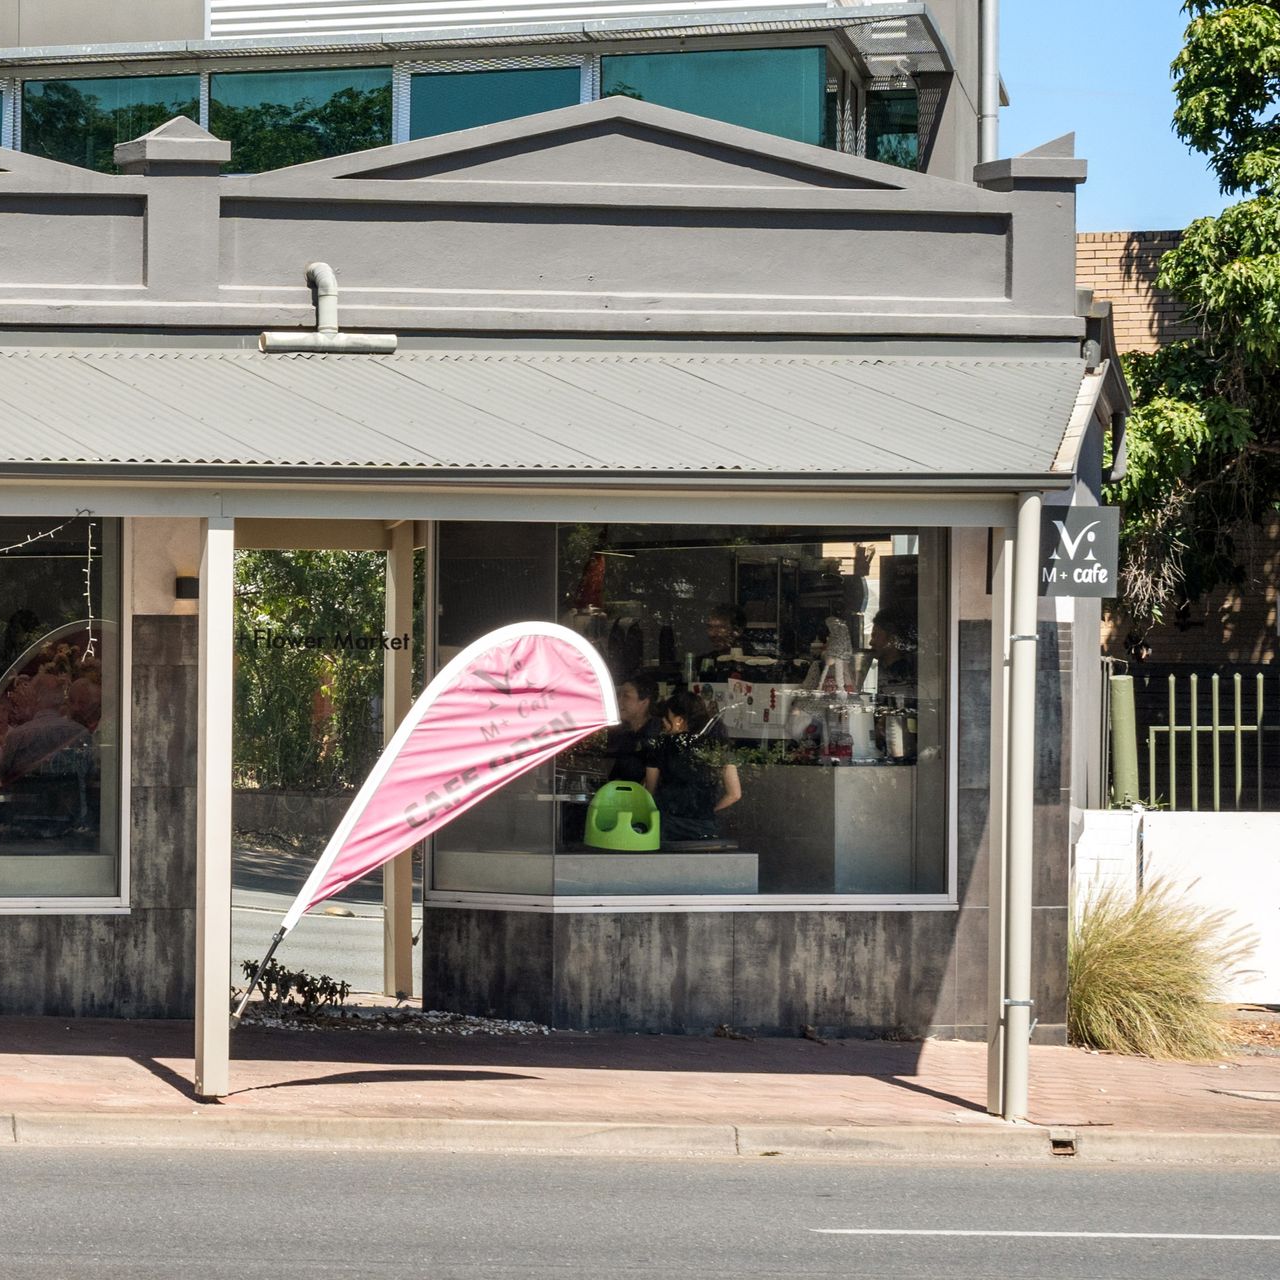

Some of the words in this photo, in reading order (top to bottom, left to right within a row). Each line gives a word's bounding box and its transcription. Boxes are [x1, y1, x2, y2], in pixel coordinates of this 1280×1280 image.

[1072, 562, 1109, 584] cafe
[333, 630, 411, 651] Market
[404, 767, 485, 828] CAFE
